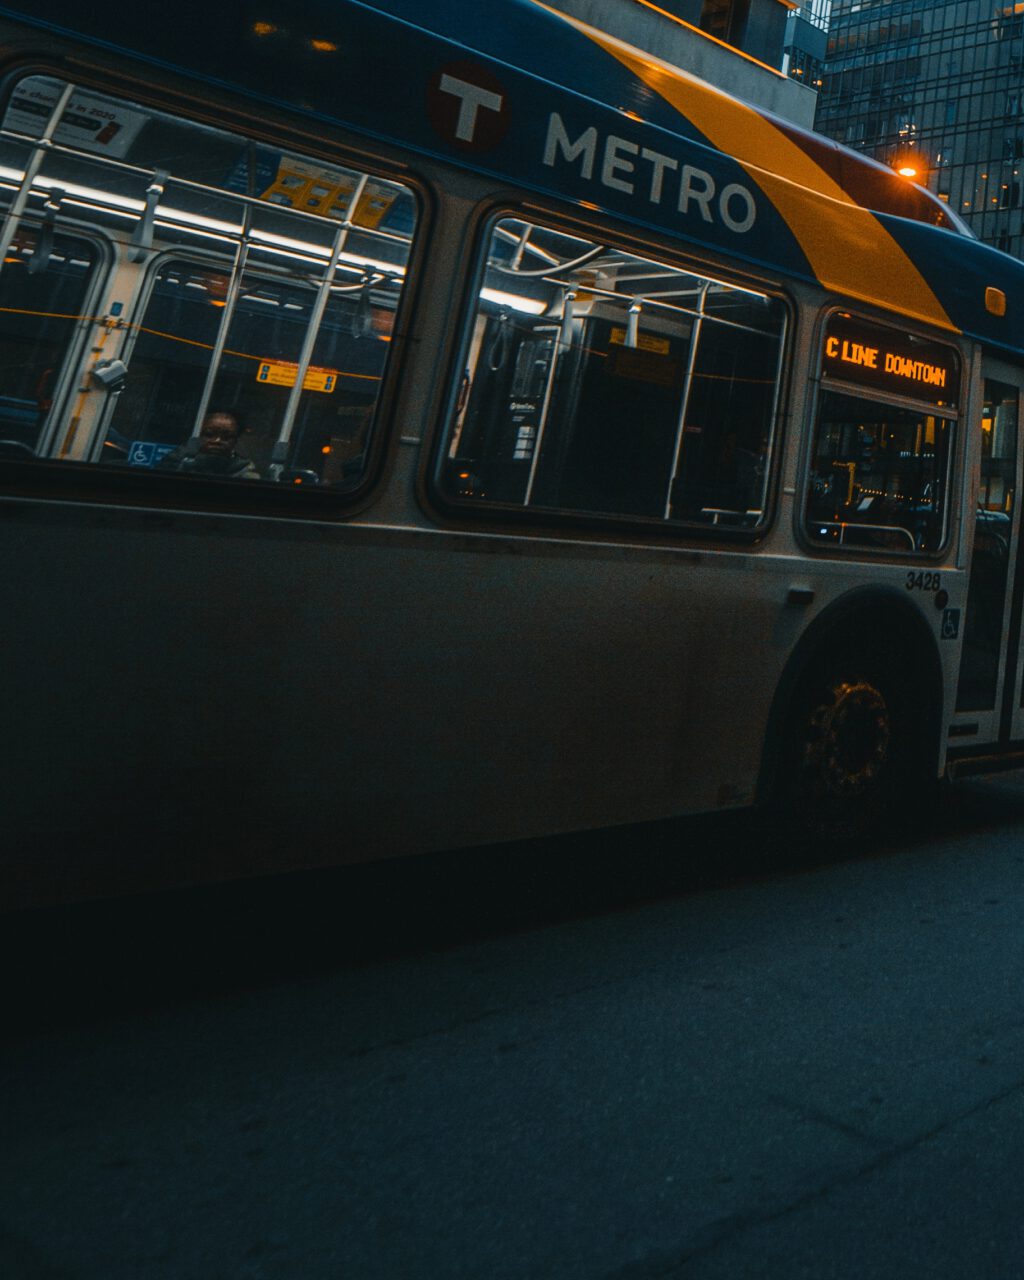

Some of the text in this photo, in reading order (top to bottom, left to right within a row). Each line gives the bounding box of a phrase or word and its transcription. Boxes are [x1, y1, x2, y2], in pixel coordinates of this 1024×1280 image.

[439, 73, 503, 143] T
[542, 112, 757, 233] METRO
[826, 336, 946, 388] C LINE DOWNTOWN
[906, 571, 940, 590] 3428
